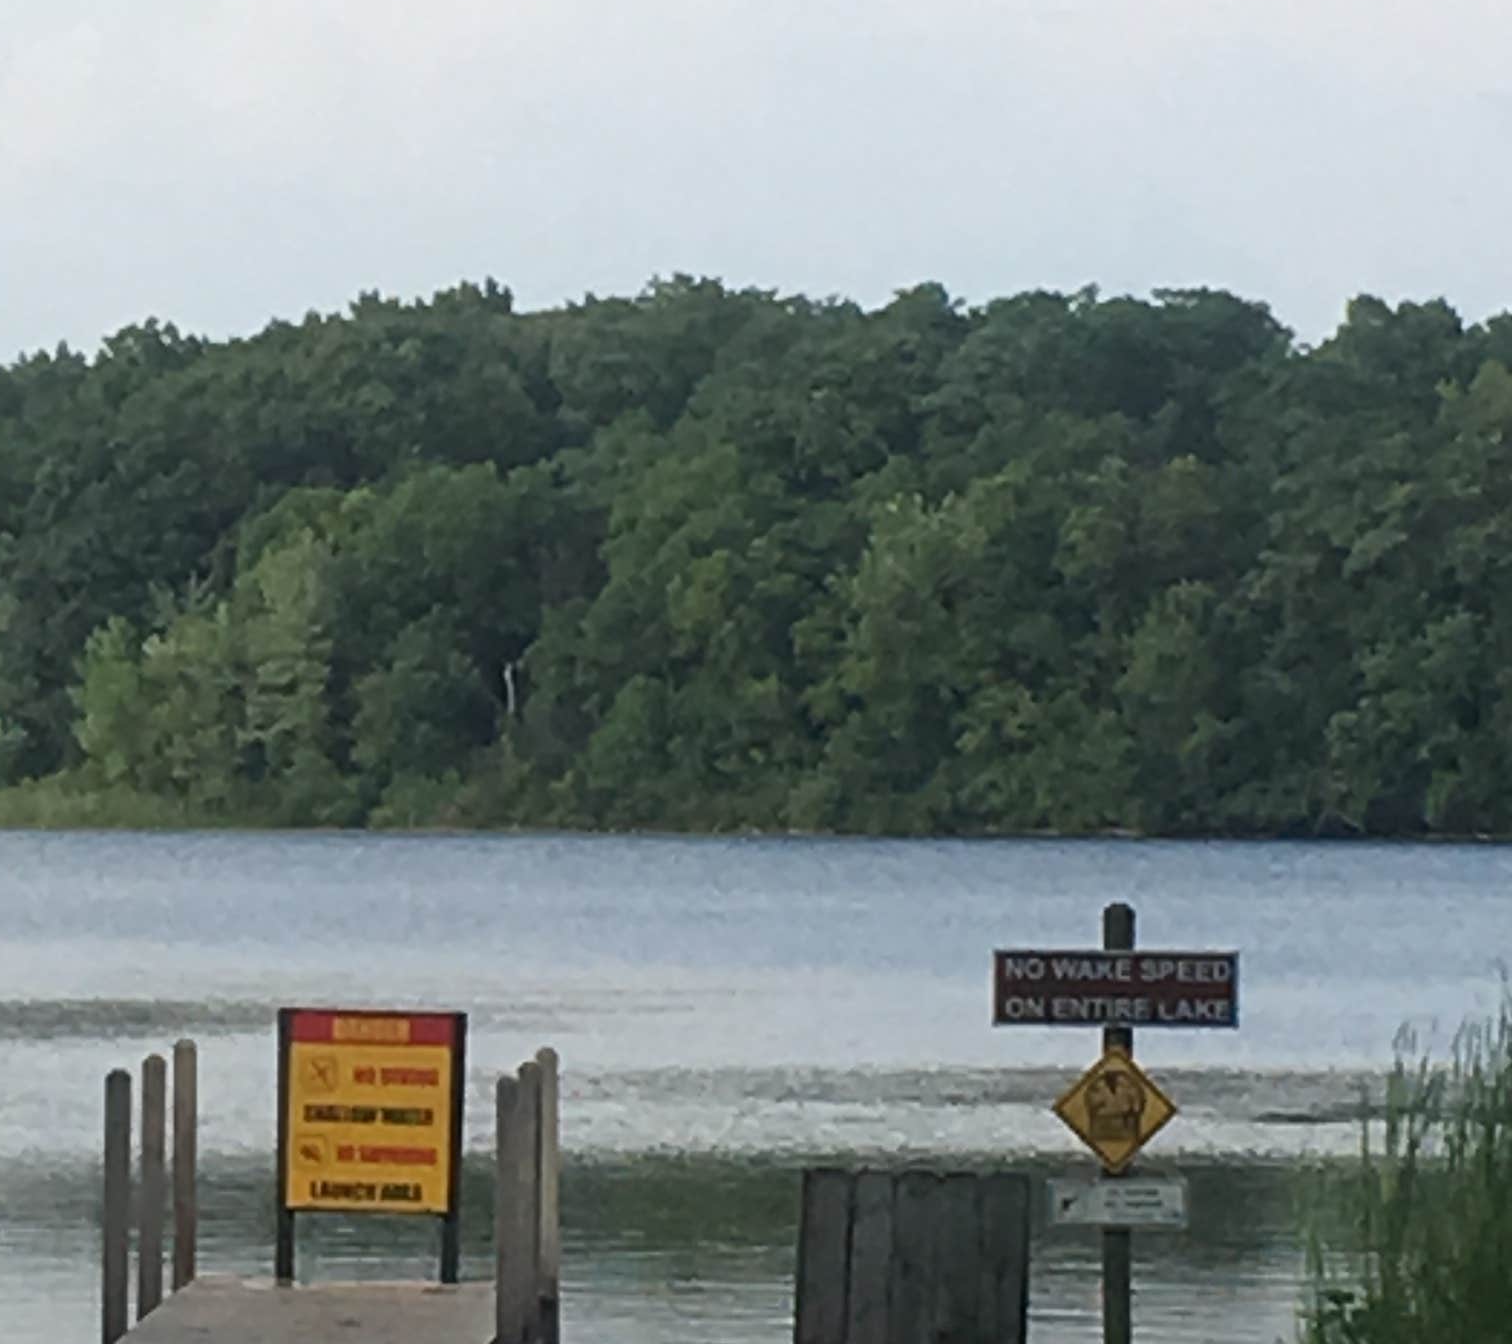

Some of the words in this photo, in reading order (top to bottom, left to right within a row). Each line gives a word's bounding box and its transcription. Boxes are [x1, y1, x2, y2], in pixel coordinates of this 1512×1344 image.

[1004, 957, 1044, 980] NO
[1051, 958, 1131, 981] WAKE
[1140, 959, 1230, 983] SPEED
[1004, 996, 1044, 1018] ON
[1051, 998, 1151, 1020] ENTIRE
[1157, 998, 1230, 1020] LAKE
